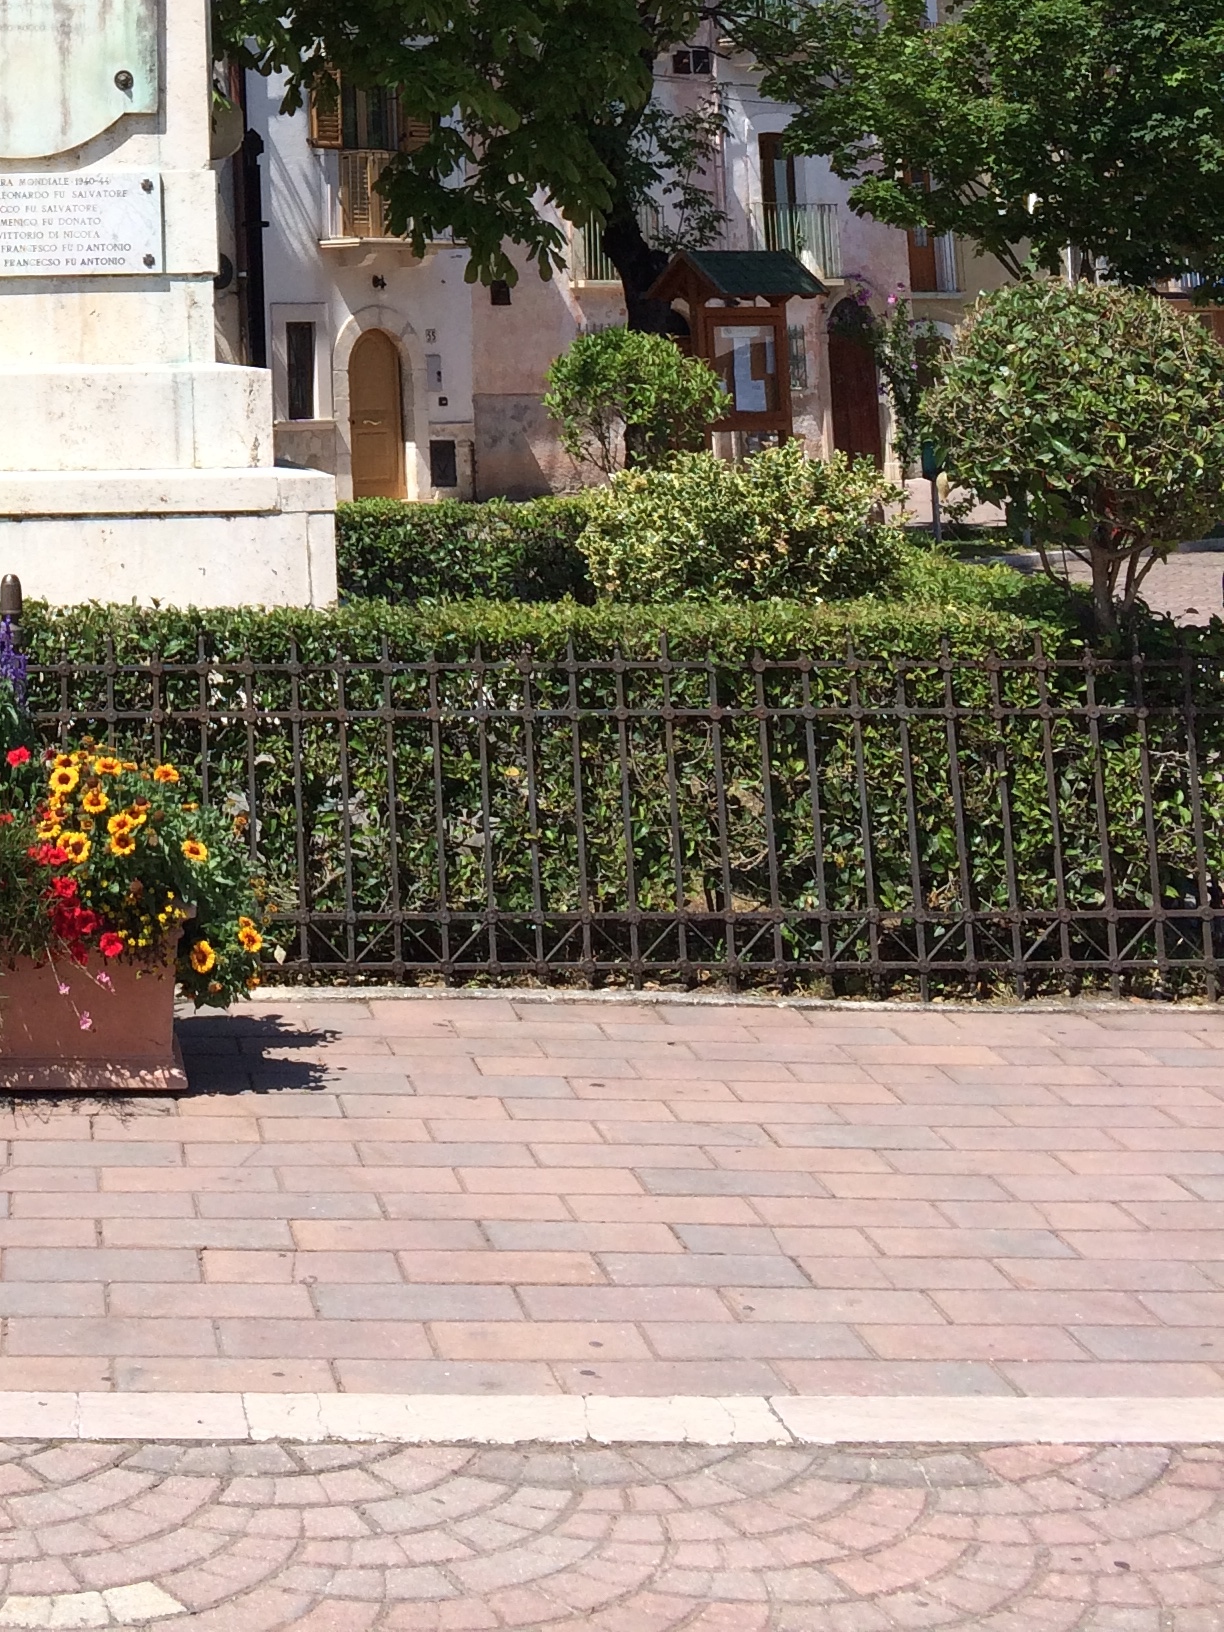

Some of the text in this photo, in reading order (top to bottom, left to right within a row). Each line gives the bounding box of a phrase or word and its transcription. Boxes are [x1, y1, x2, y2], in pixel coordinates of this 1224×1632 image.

[19, 178, 69, 186] MONDIALE
[72, 190, 128, 198] SALVATORE
[25, 205, 36, 213] FU
[42, 205, 98, 213] SALVATORE
[42, 218, 53, 226] FU
[59, 217, 101, 225] DONATO
[49, 231, 59, 239] DI
[63, 231, 100, 239] NICOLA
[1, 244, 57, 253] FRANCESCO
[86, 243, 132, 251] ANTONIO
[80, 257, 126, 266] ANTONIO
